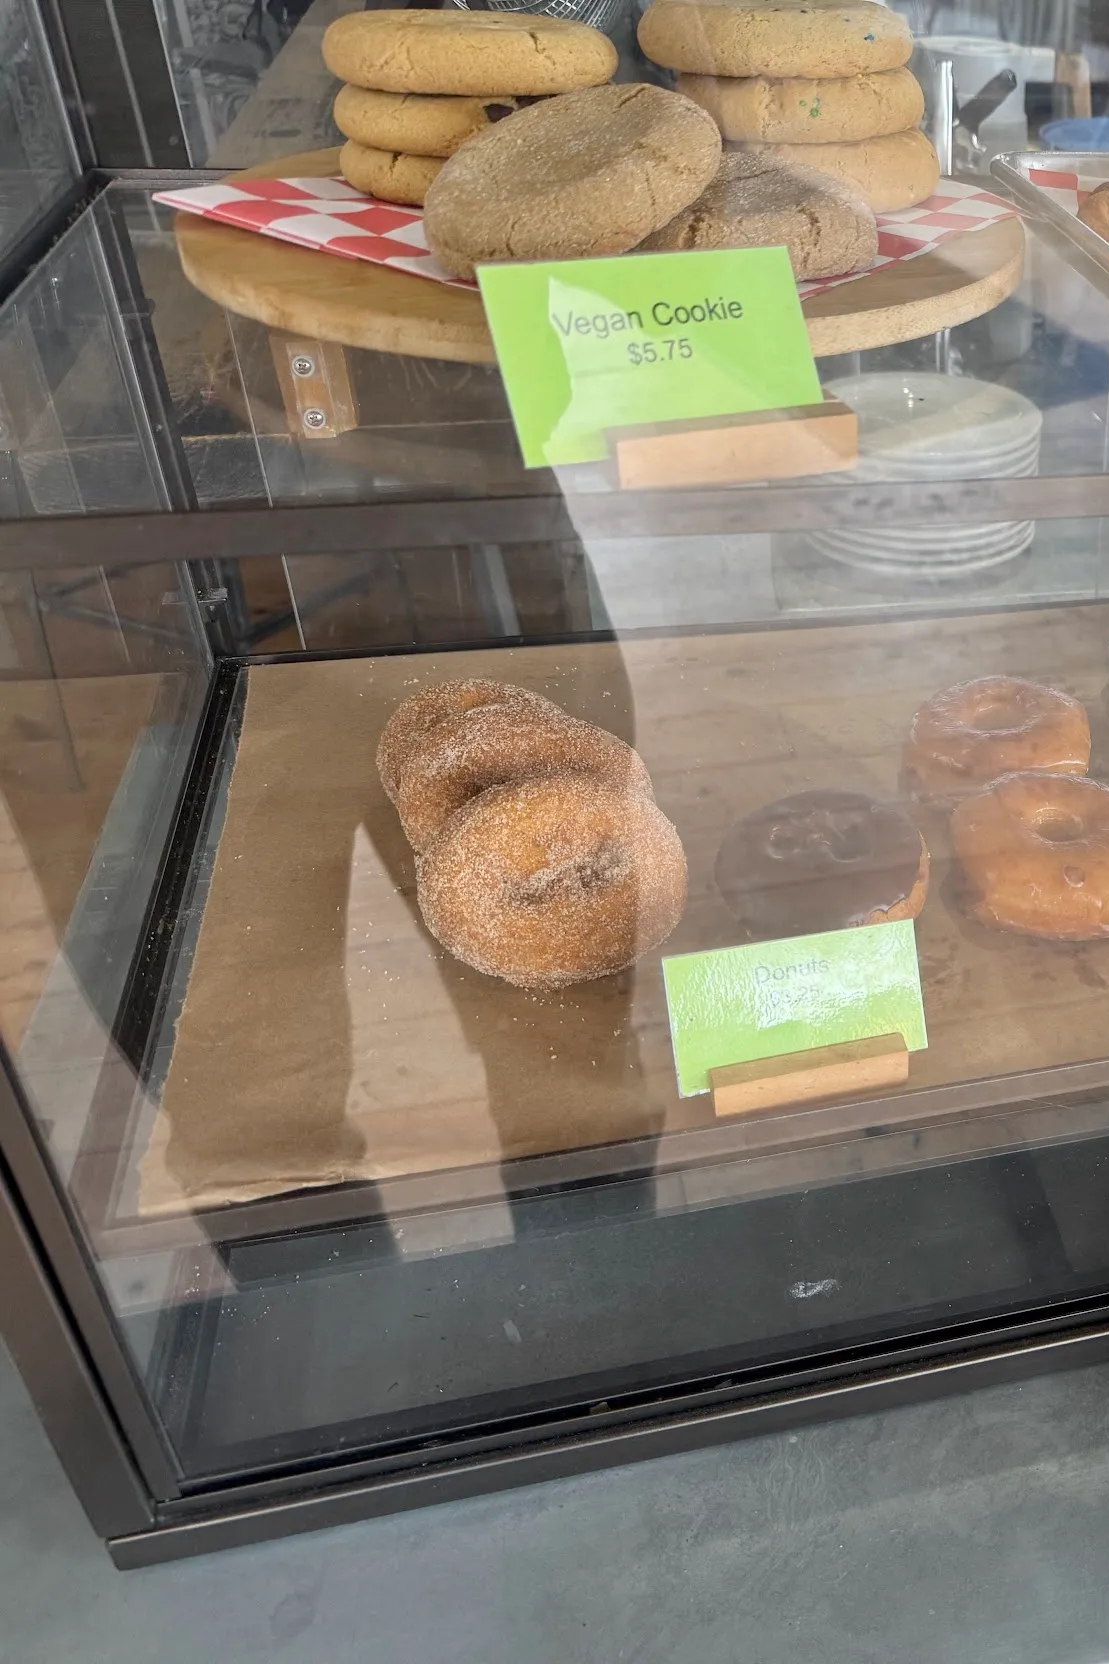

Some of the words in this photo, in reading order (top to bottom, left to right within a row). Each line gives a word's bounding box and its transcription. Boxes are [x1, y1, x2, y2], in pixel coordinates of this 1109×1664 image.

[551, 310, 644, 339] Vegan
[651, 296, 744, 326] Cookie
[627, 338, 693, 366] $5.75
[755, 958, 829, 986] Donuts
